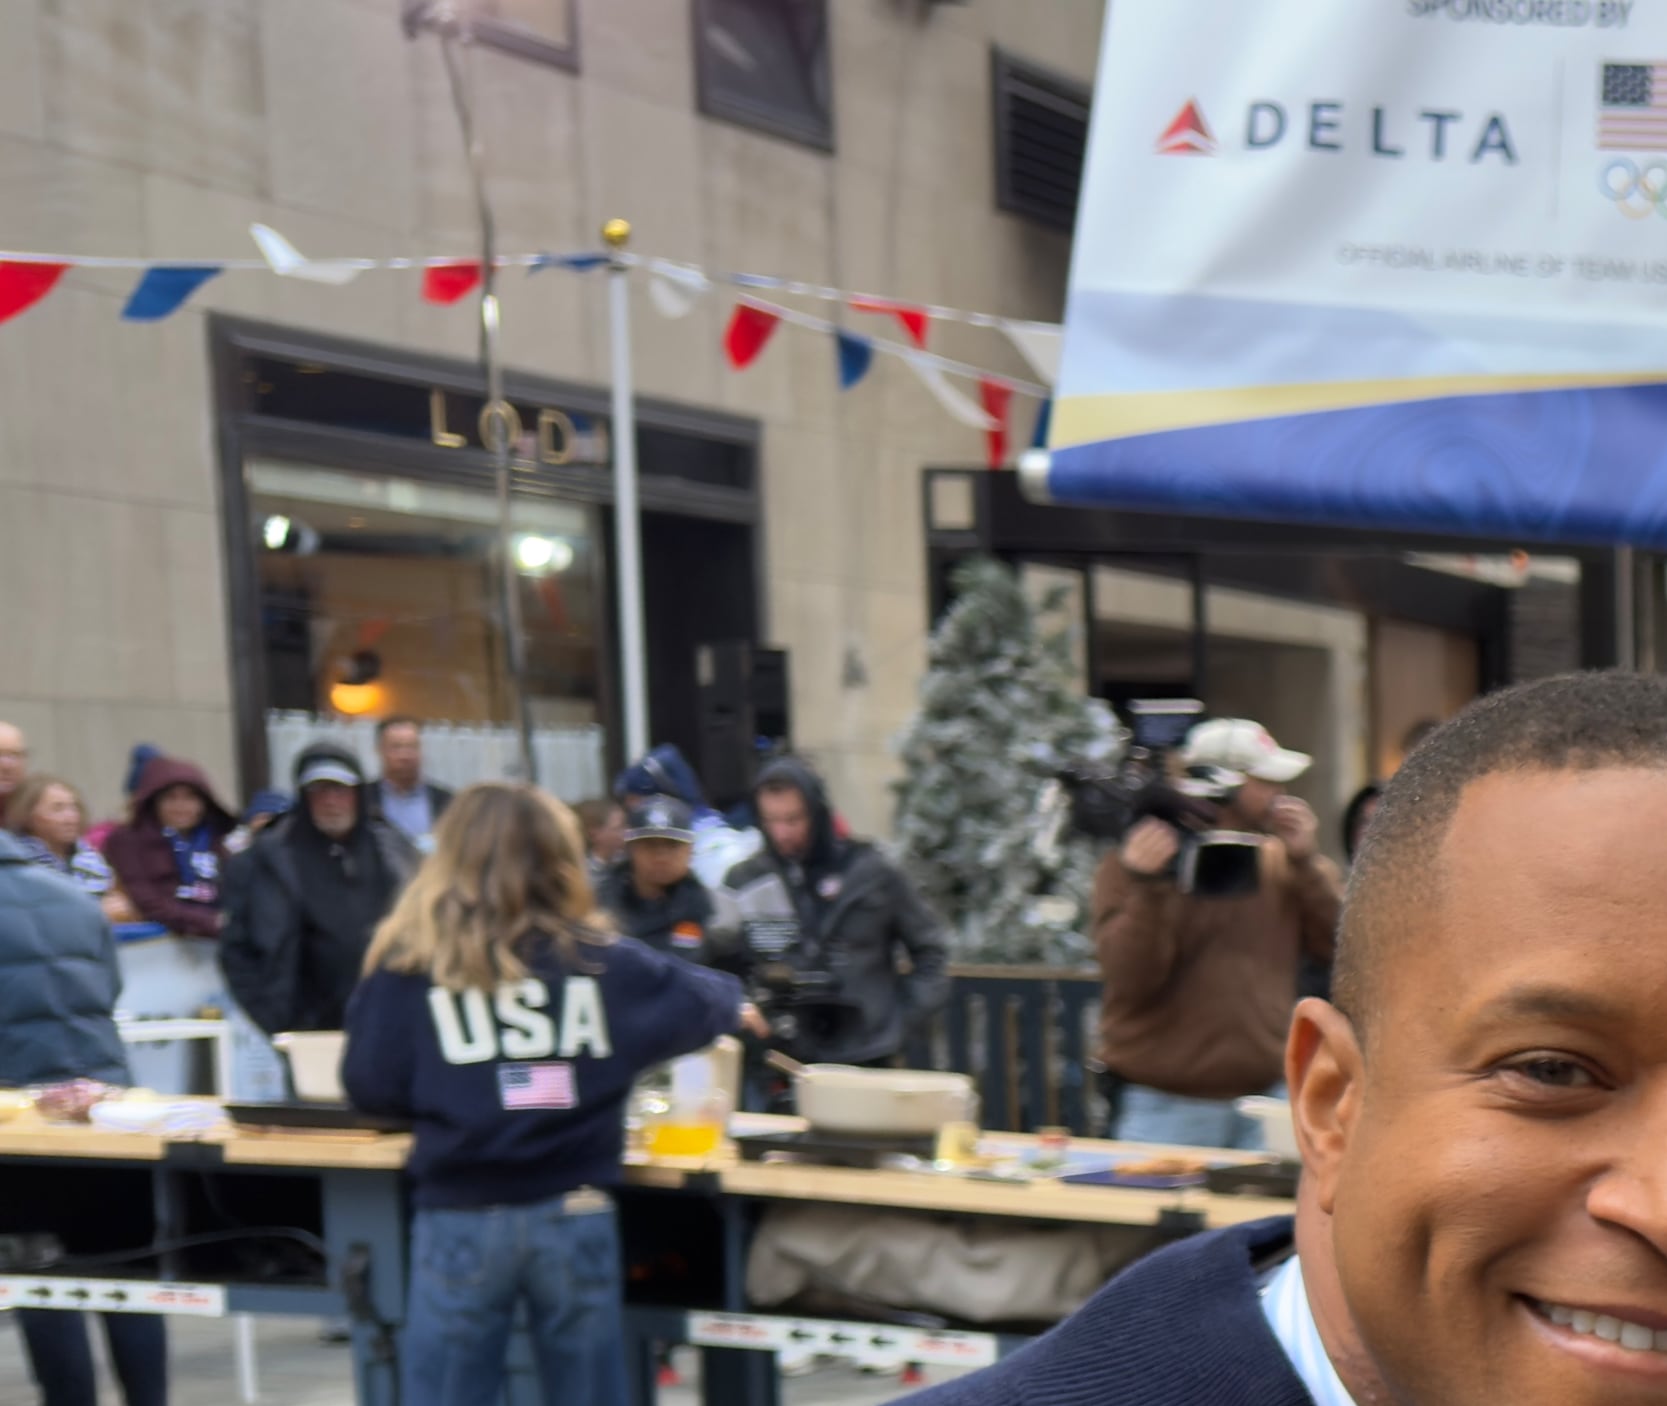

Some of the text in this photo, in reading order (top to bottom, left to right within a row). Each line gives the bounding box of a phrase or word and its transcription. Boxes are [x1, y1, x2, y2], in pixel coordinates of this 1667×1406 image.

[1246, 100, 1519, 164] DELTA
[1336, 243, 1436, 271] OFFICIAL
[1444, 247, 1529, 277] AIRLINE
[1534, 252, 1566, 279] OF
[1571, 254, 1634, 282] TEAM
[427, 974, 613, 1065] USA
